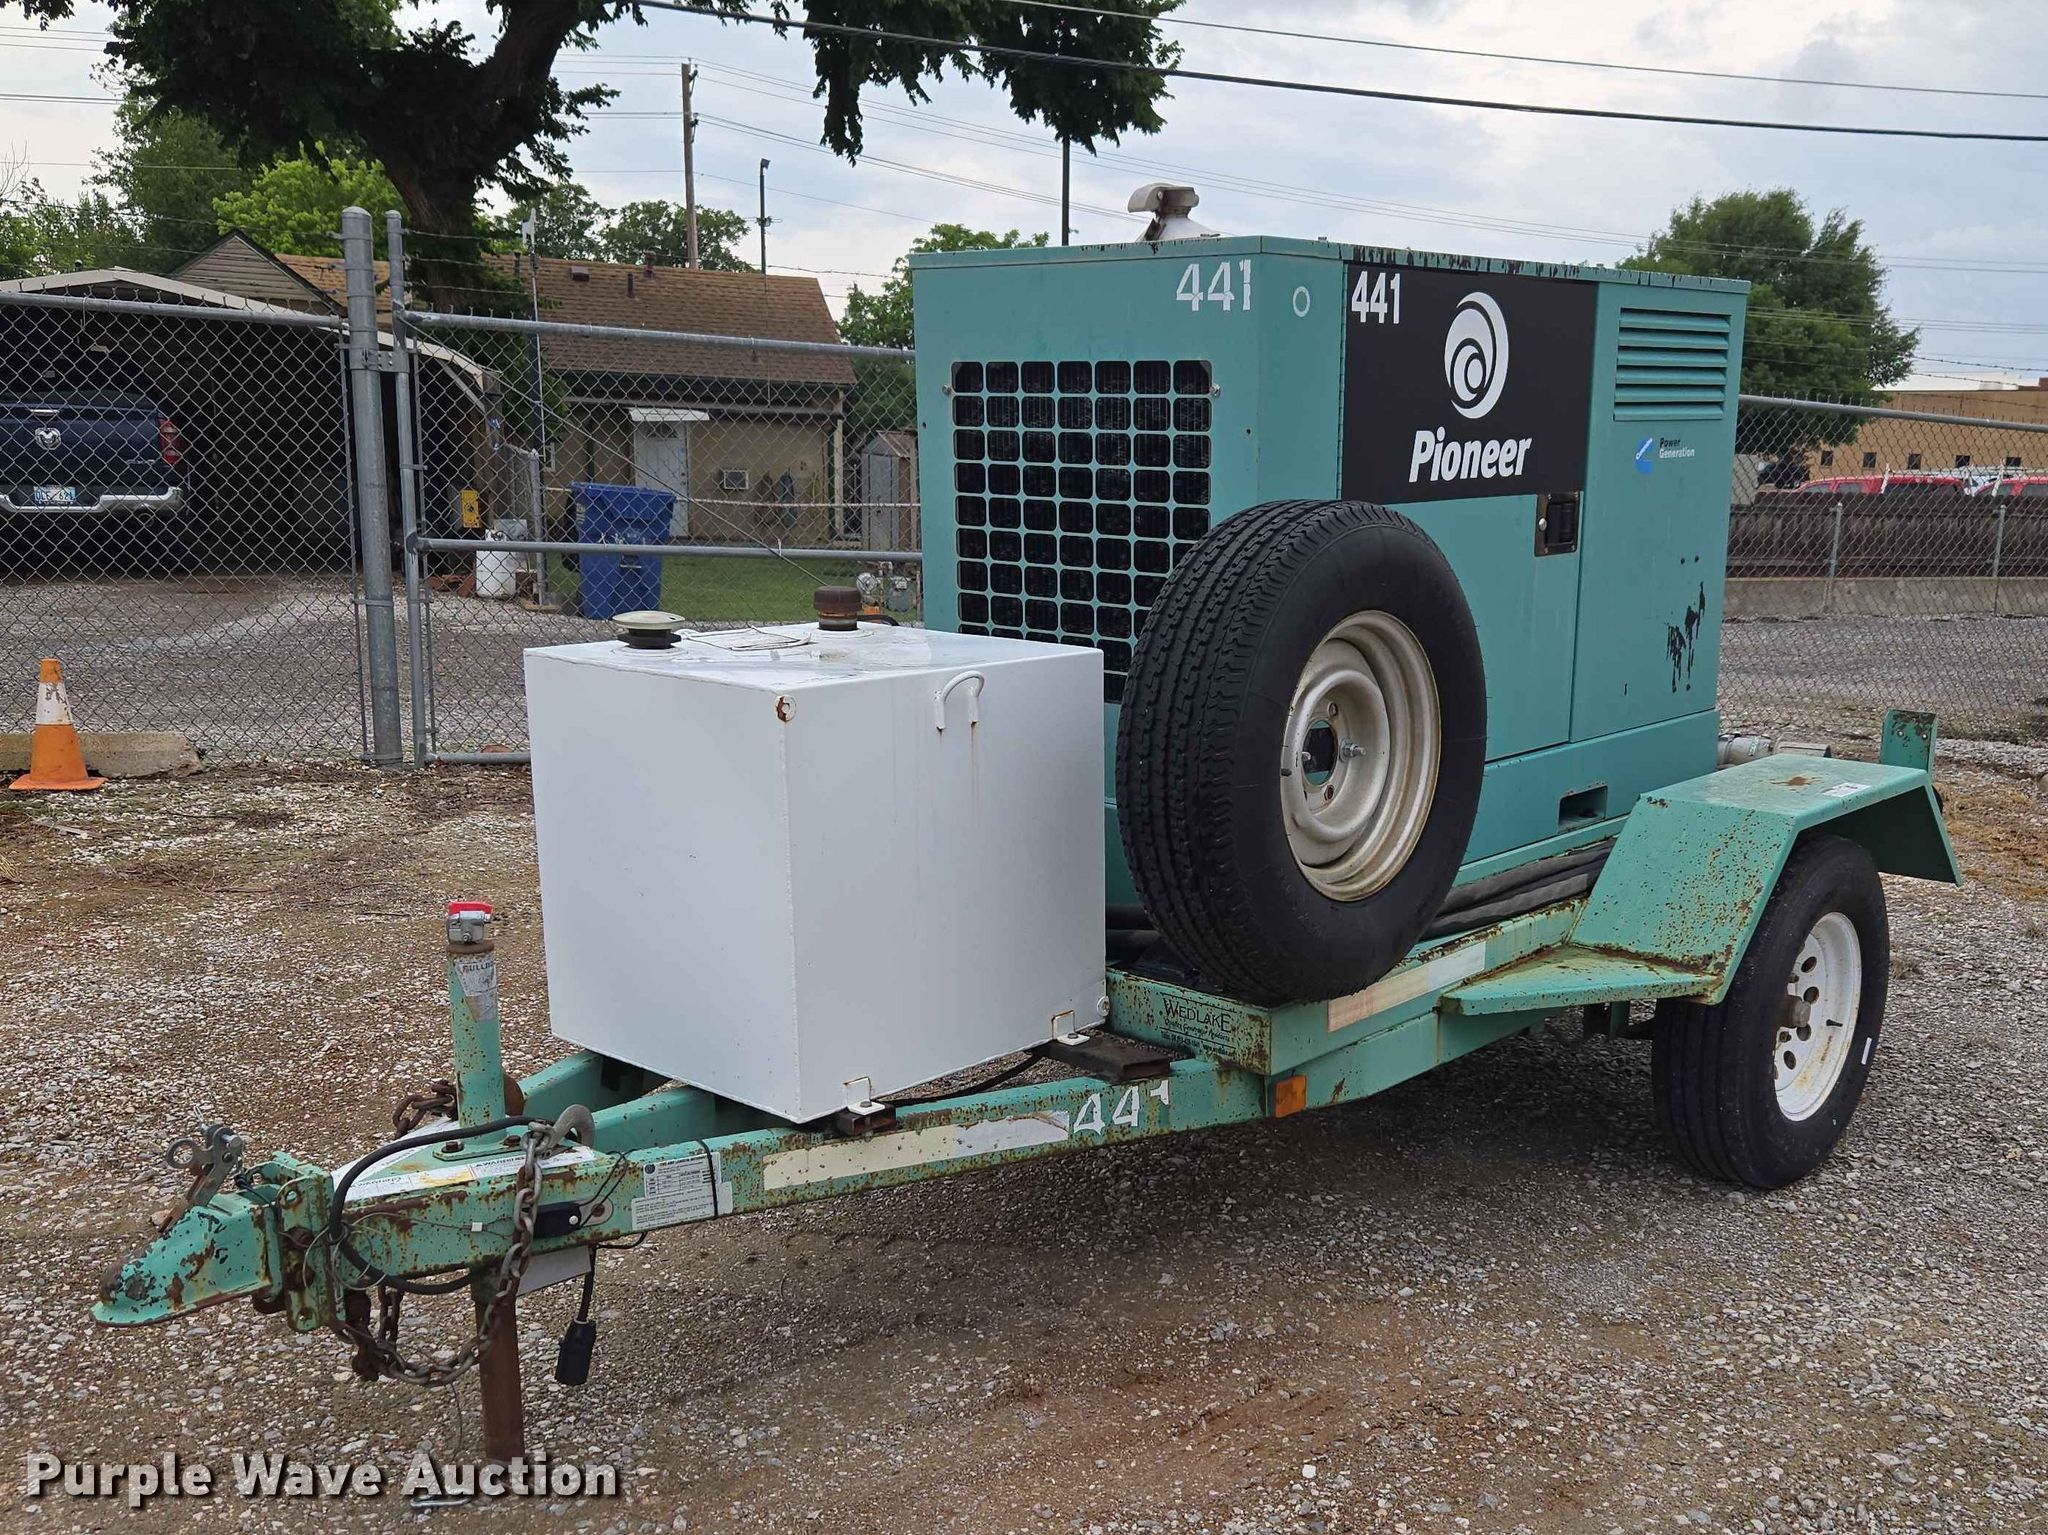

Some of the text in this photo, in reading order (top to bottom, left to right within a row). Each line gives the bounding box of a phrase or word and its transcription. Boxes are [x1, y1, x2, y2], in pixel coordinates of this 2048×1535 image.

[1176, 259, 1251, 312] 441
[1351, 270, 1401, 325] 441
[1408, 426, 1533, 483] Pioneer
[1659, 437, 1681, 448] Power
[1659, 446, 1695, 459] Generation
[1163, 997, 1232, 1034] WEDLAKE
